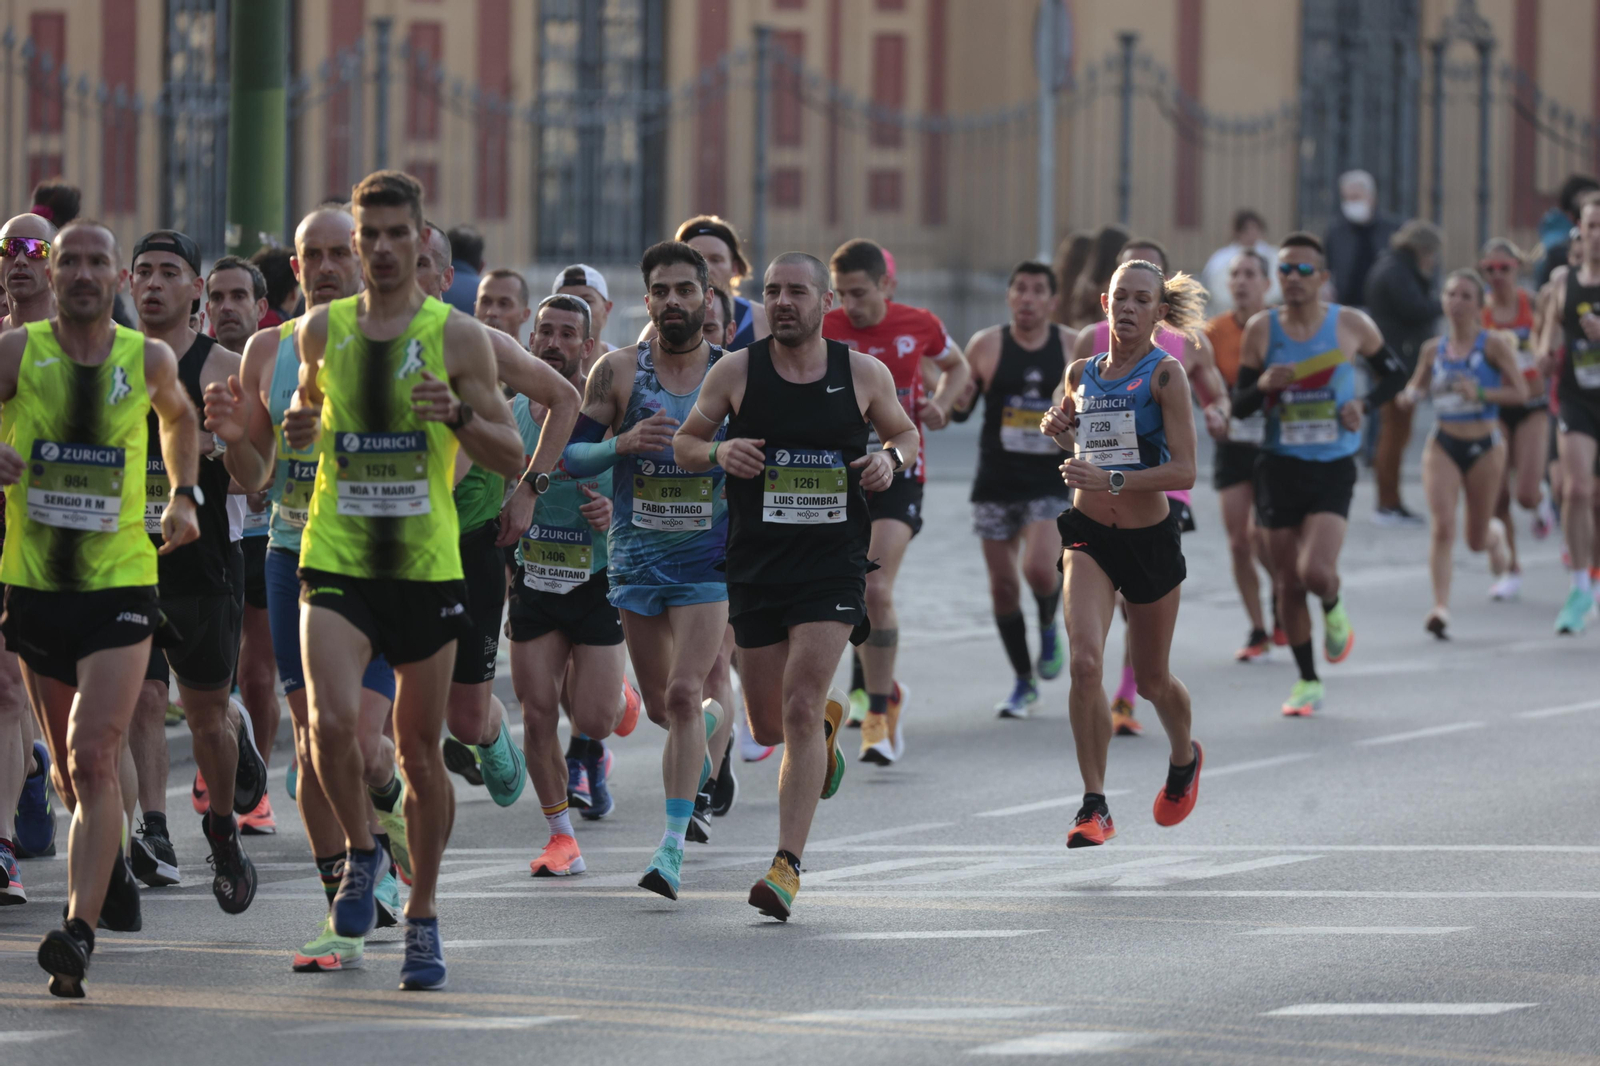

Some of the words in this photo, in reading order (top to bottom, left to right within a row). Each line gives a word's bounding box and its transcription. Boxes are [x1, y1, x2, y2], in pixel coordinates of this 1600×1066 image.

[1090, 399, 1126, 409] ZURICH
[1089, 421, 1110, 432] F229
[363, 436, 416, 449] ZURICH
[1085, 439, 1119, 449] ADRIANA
[63, 448, 116, 463] ZURICH
[793, 454, 836, 465] ZURIC
[366, 464, 396, 477] 1576
[64, 475, 88, 488] 984
[793, 477, 820, 489] 1261
[350, 485, 369, 496] NOA
[372, 486, 378, 496] Y
[382, 485, 416, 496] MARIO
[661, 487, 682, 498] 878
[44, 494, 82, 507] SERGIO
[85, 498, 92, 508] R
[95, 499, 105, 509] M
[774, 495, 794, 505] LUIS
[796, 496, 838, 506] COIMBRA
[641, 502, 703, 514] FABIO-THIAGO
[289, 510, 308, 521] DIEG
[541, 528, 583, 541] ZURICH
[541, 550, 566, 563] 1406
[548, 568, 586, 580] CANTANO
